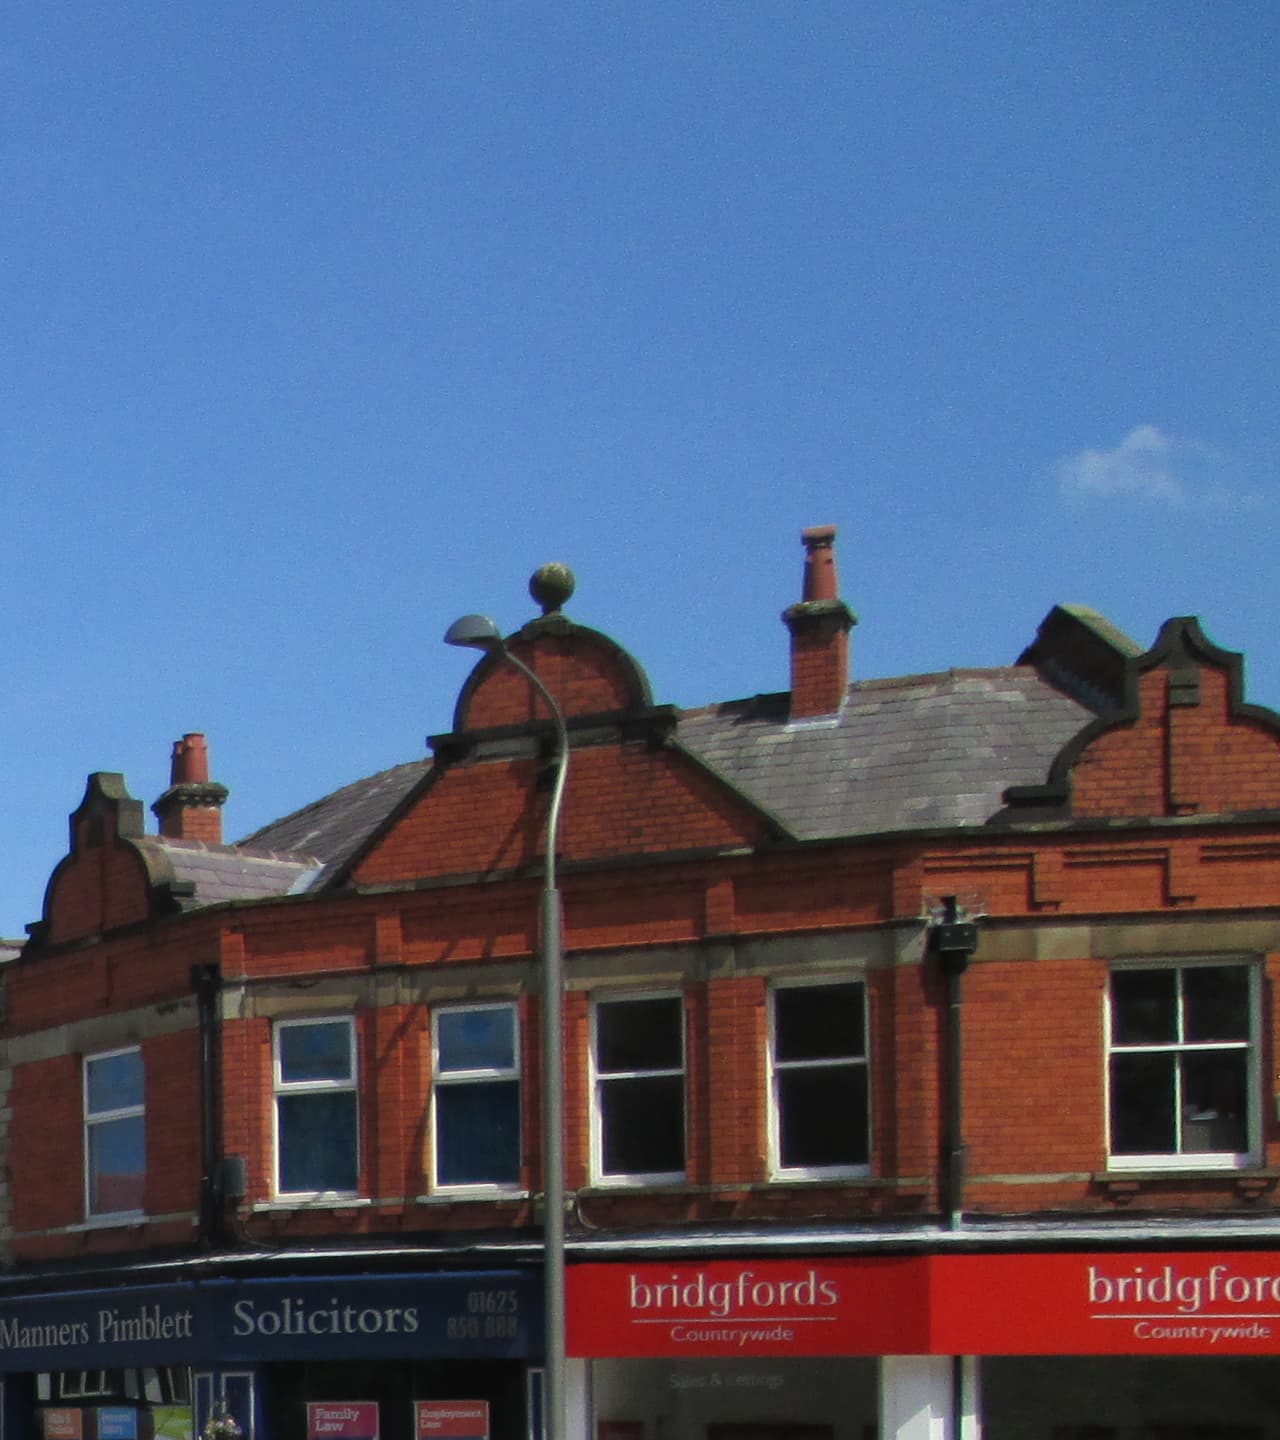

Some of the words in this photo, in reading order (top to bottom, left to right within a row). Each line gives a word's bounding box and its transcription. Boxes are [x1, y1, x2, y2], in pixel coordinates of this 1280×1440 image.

[468, 1290, 518, 1313] 01625
[629, 1271, 839, 1316] bridgfords
[0, 1318, 89, 1350] Manners
[98, 1305, 192, 1343] Pimblett
[233, 1298, 419, 1336] Solicitors
[671, 1325, 793, 1346] Countrywide
[1133, 1322, 1271, 1344] Countrywide
[315, 1408, 360, 1421] Family
[420, 1409, 483, 1420] Employment
[421, 1420, 442, 1429] Law
[315, 1420, 344, 1432] Law
